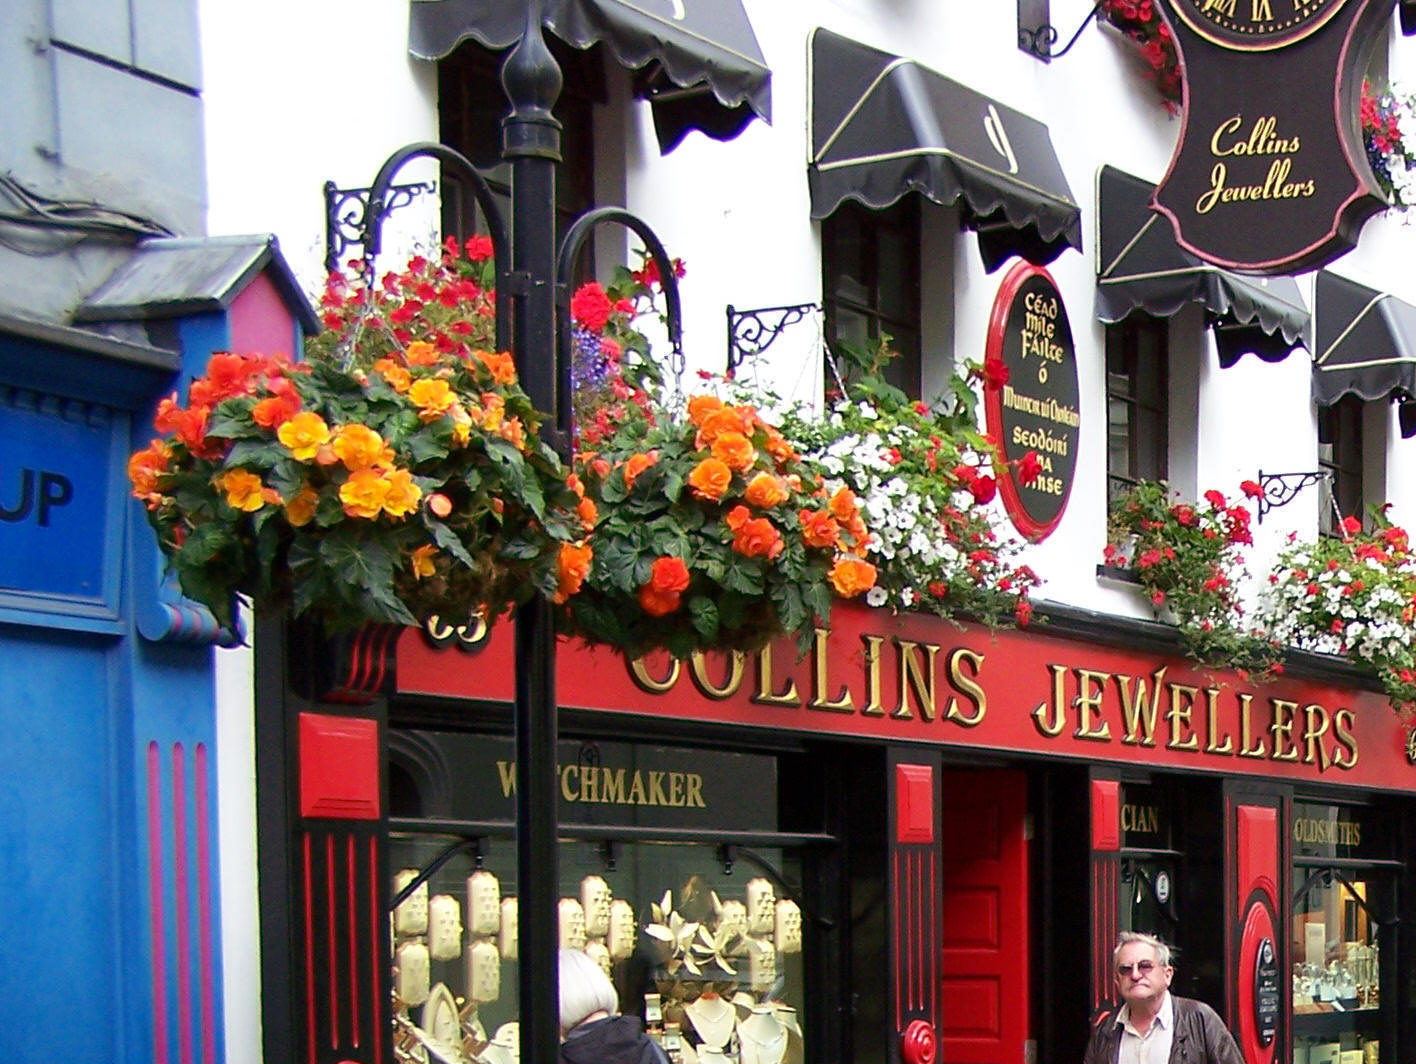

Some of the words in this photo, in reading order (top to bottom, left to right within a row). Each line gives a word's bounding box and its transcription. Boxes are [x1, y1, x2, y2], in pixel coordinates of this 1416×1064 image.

[1210, 116, 1301, 156] Collins
[1196, 158, 1316, 214] Jewellers
[1031, 663, 1359, 771] JEWELLERS
[496, 761, 706, 808] WCHMAKER
